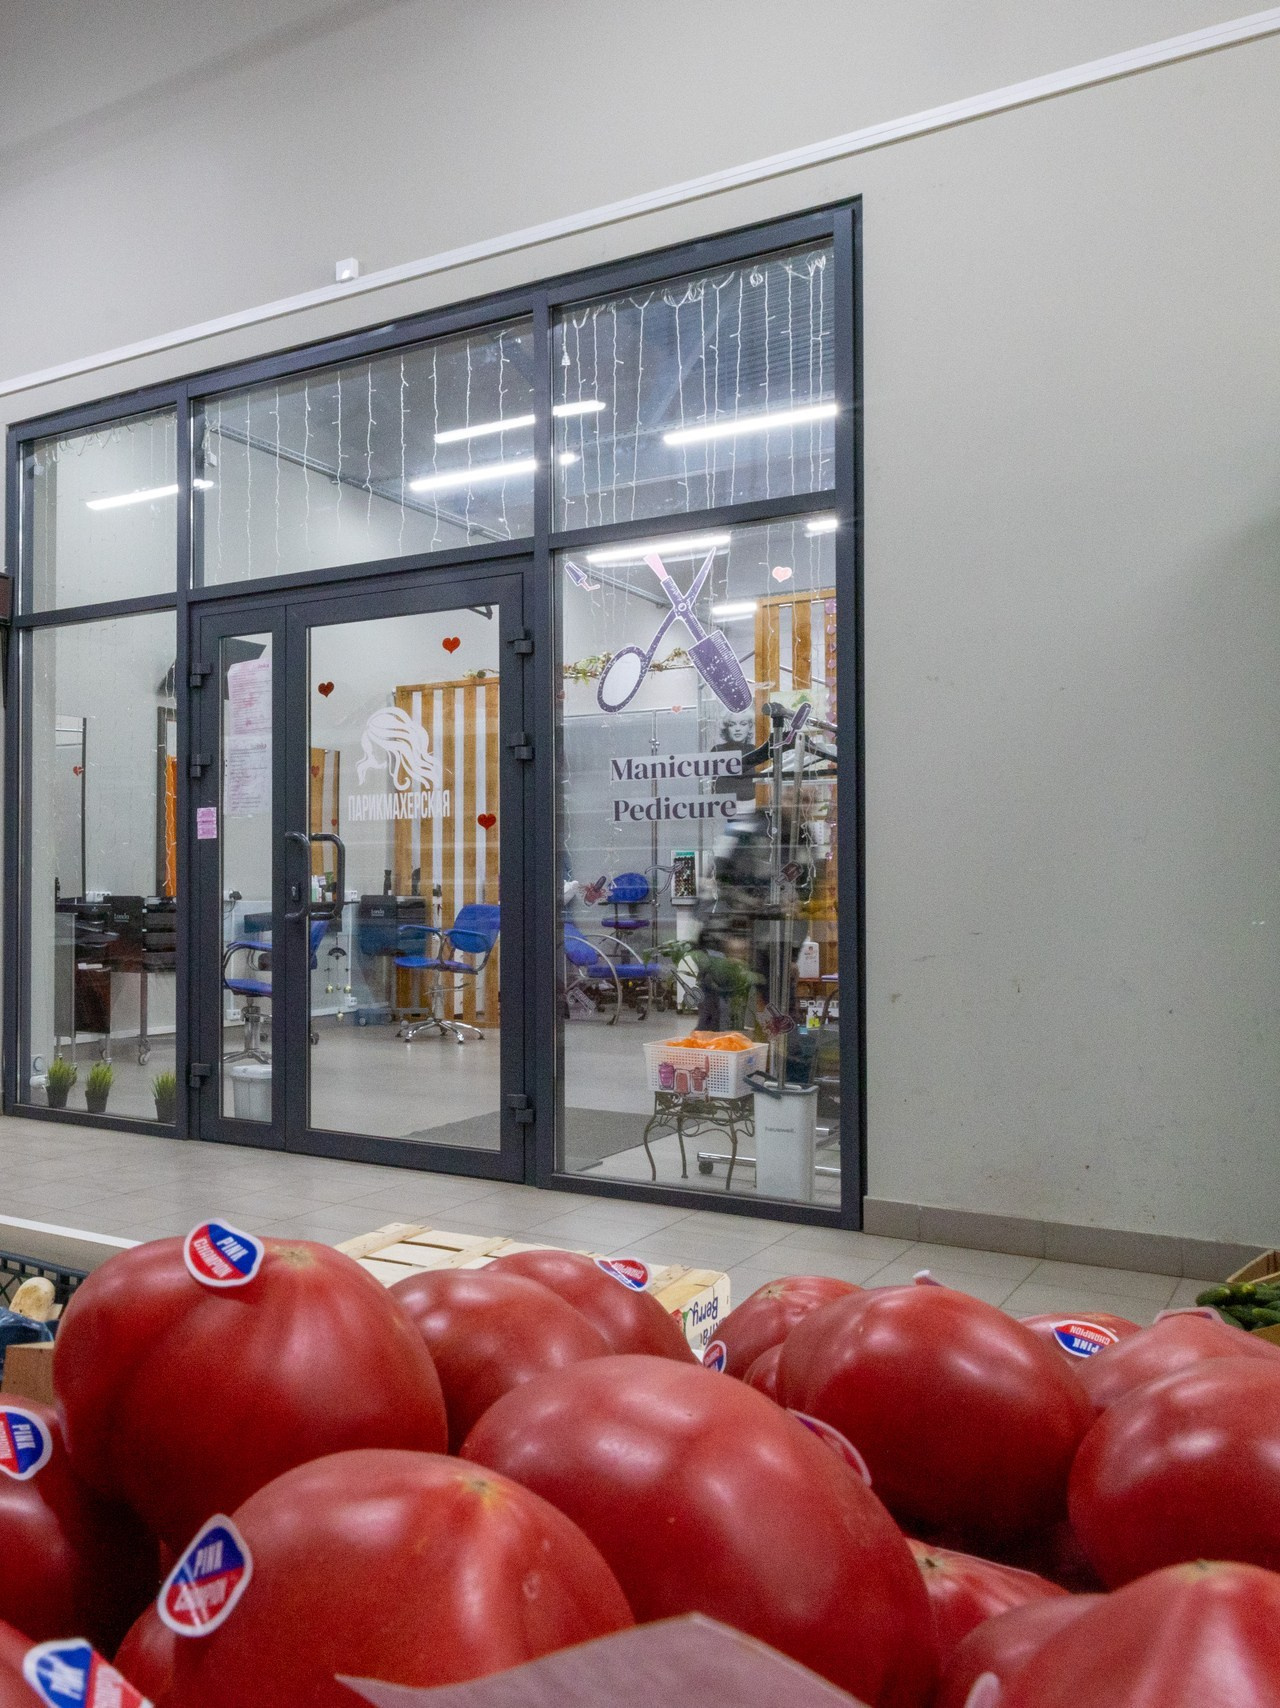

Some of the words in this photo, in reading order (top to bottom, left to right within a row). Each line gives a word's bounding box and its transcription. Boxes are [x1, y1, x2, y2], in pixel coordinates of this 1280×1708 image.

[611, 755, 741, 781] Manicure
[348, 790, 450, 821] ПАРИКМАХЕРСКАЯ
[613, 797, 737, 822] Pedicure
[194, 1237, 233, 1278] CHAMPION
[216, 1236, 248, 1262] PINK
[690, 1297, 718, 1327] Berry
[1070, 1326, 1111, 1346] CHAMPION
[1073, 1337, 1099, 1353] PINK
[12, 1424, 36, 1449] PINK
[192, 1540, 224, 1578] PINK
